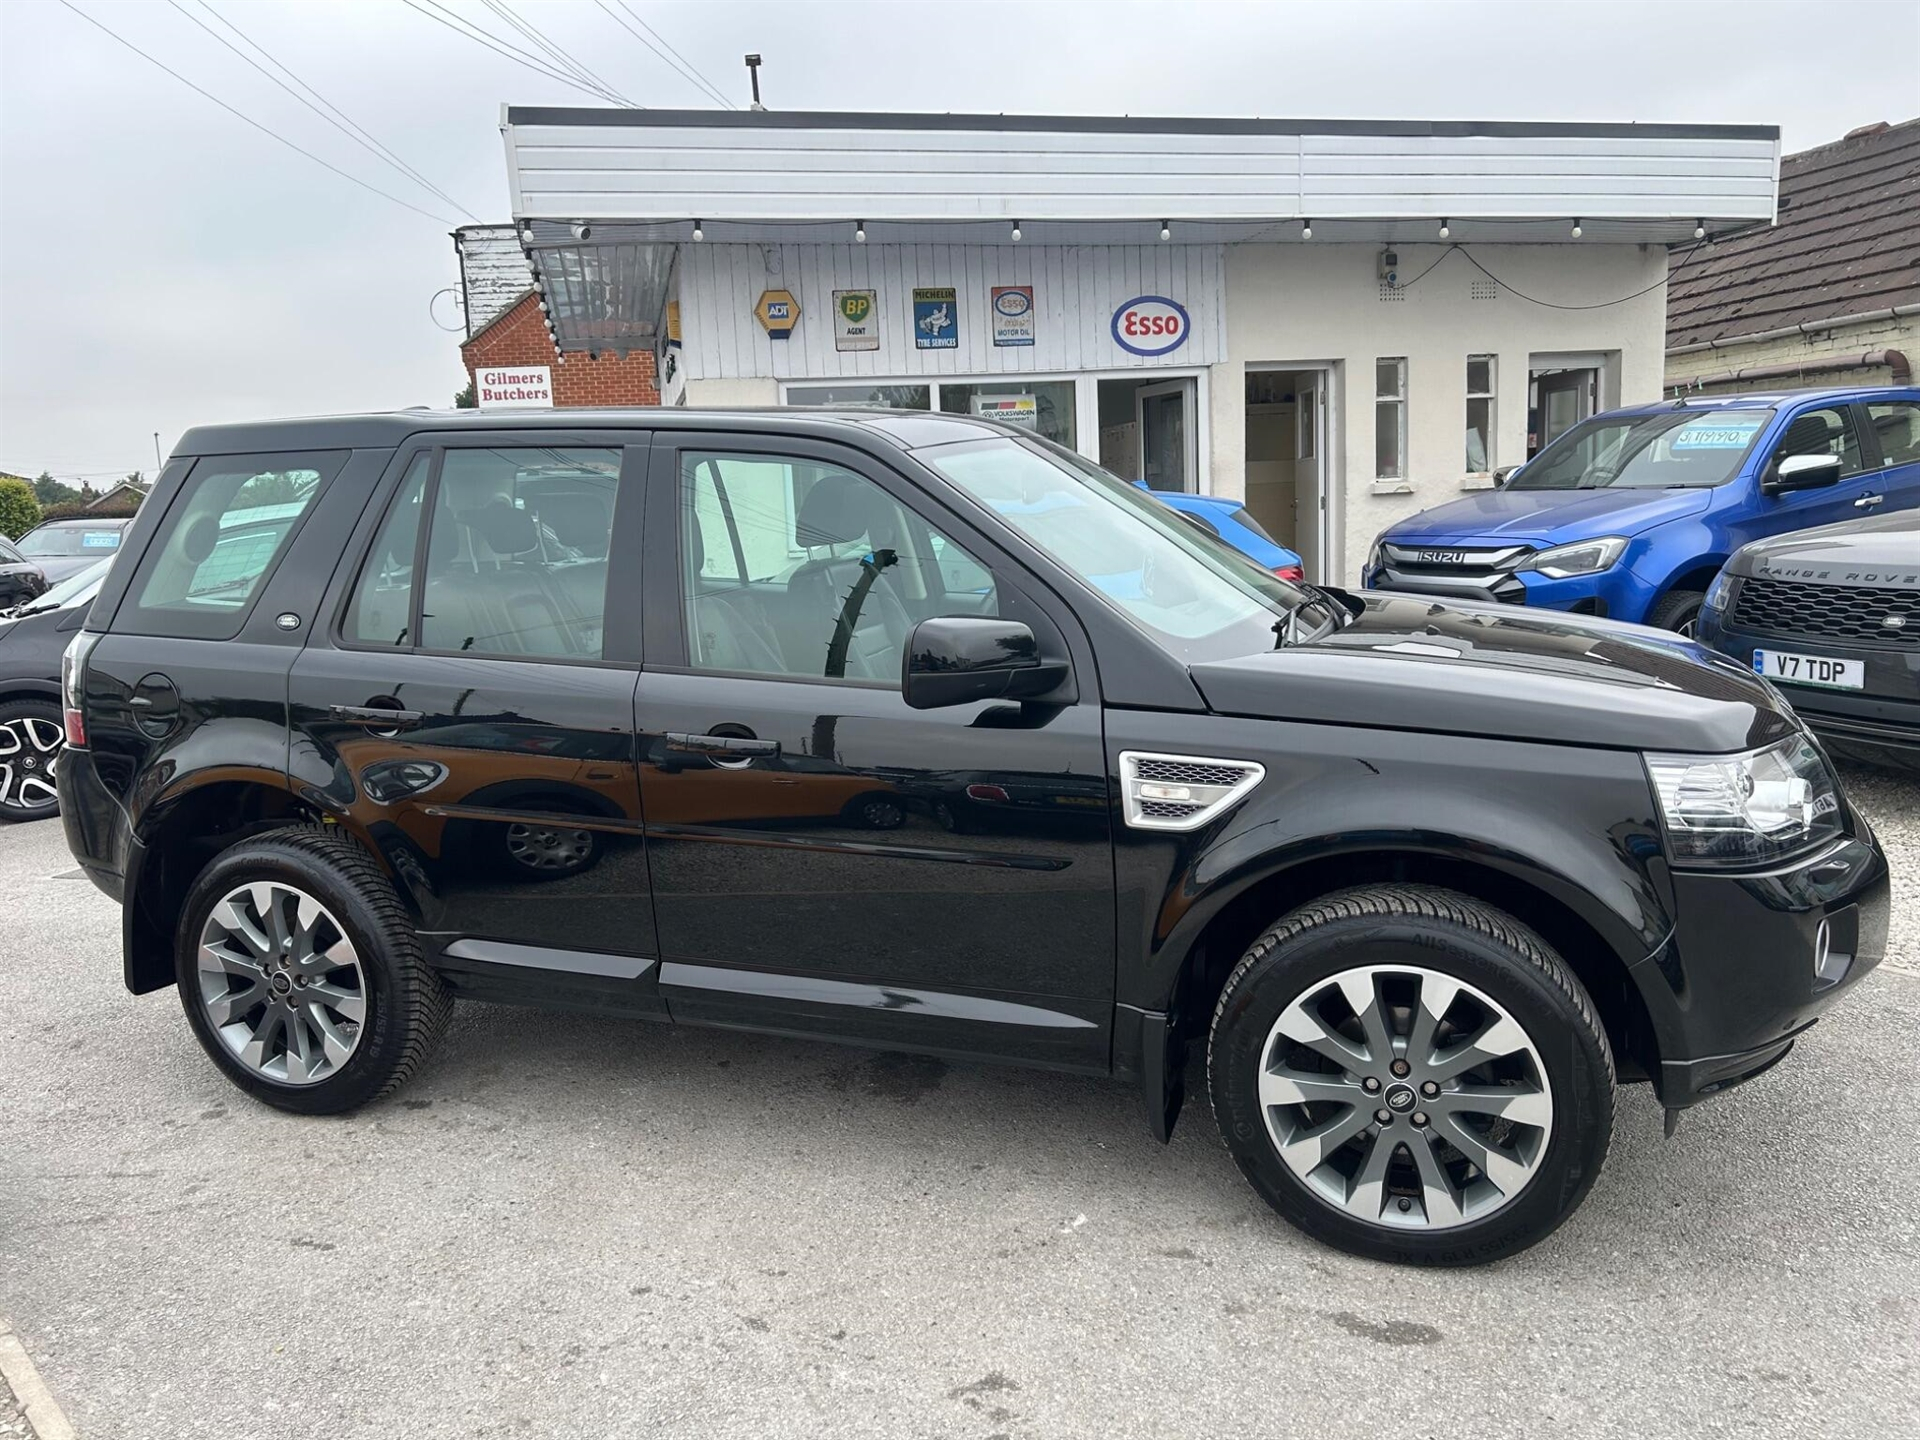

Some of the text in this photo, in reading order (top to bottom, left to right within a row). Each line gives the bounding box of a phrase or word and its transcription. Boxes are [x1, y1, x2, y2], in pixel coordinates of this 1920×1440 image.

[915, 290, 954, 299] MICHELIN
[769, 305, 788, 315] ADT
[846, 300, 867, 314] BP
[917, 338, 956, 347] TYRE SERVICES
[484, 372, 543, 385] Gilmers
[482, 388, 548, 401] Butchers
[1418, 552, 1465, 563] ISUZU
[1759, 567, 1830, 579] RANGE
[1777, 655, 1800, 677] V7
[1806, 659, 1845, 682] TDP
